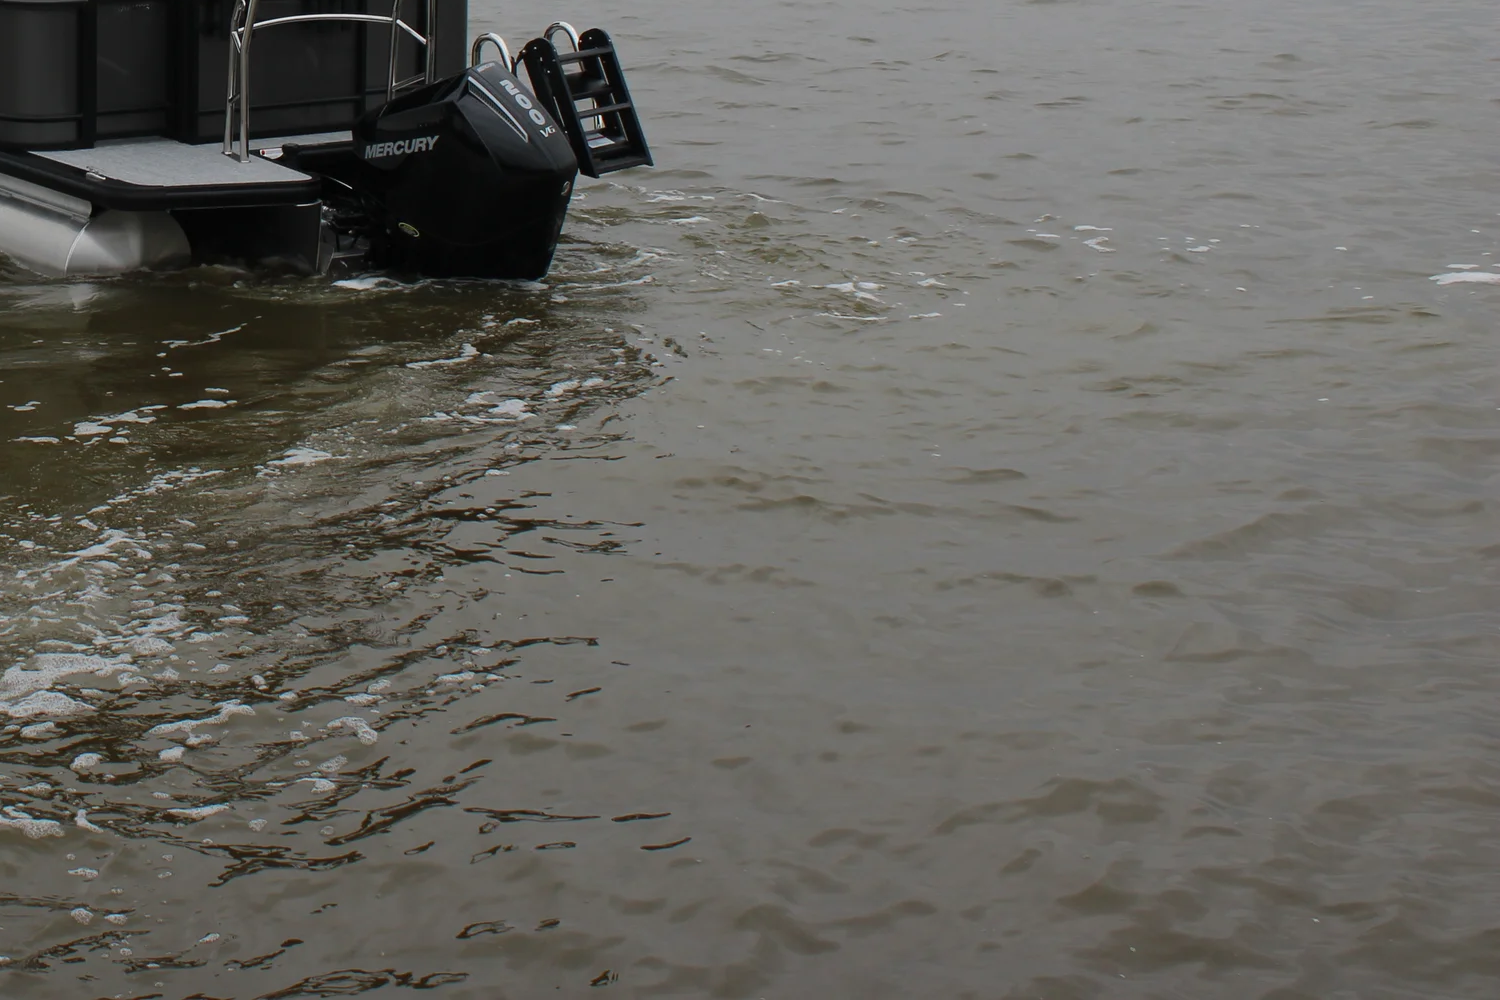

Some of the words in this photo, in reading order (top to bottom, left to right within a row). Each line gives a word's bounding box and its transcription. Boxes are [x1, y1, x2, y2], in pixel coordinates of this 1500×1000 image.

[499, 79, 546, 126] 200
[539, 125, 556, 138] V6
[364, 135, 440, 159] MERCURY
